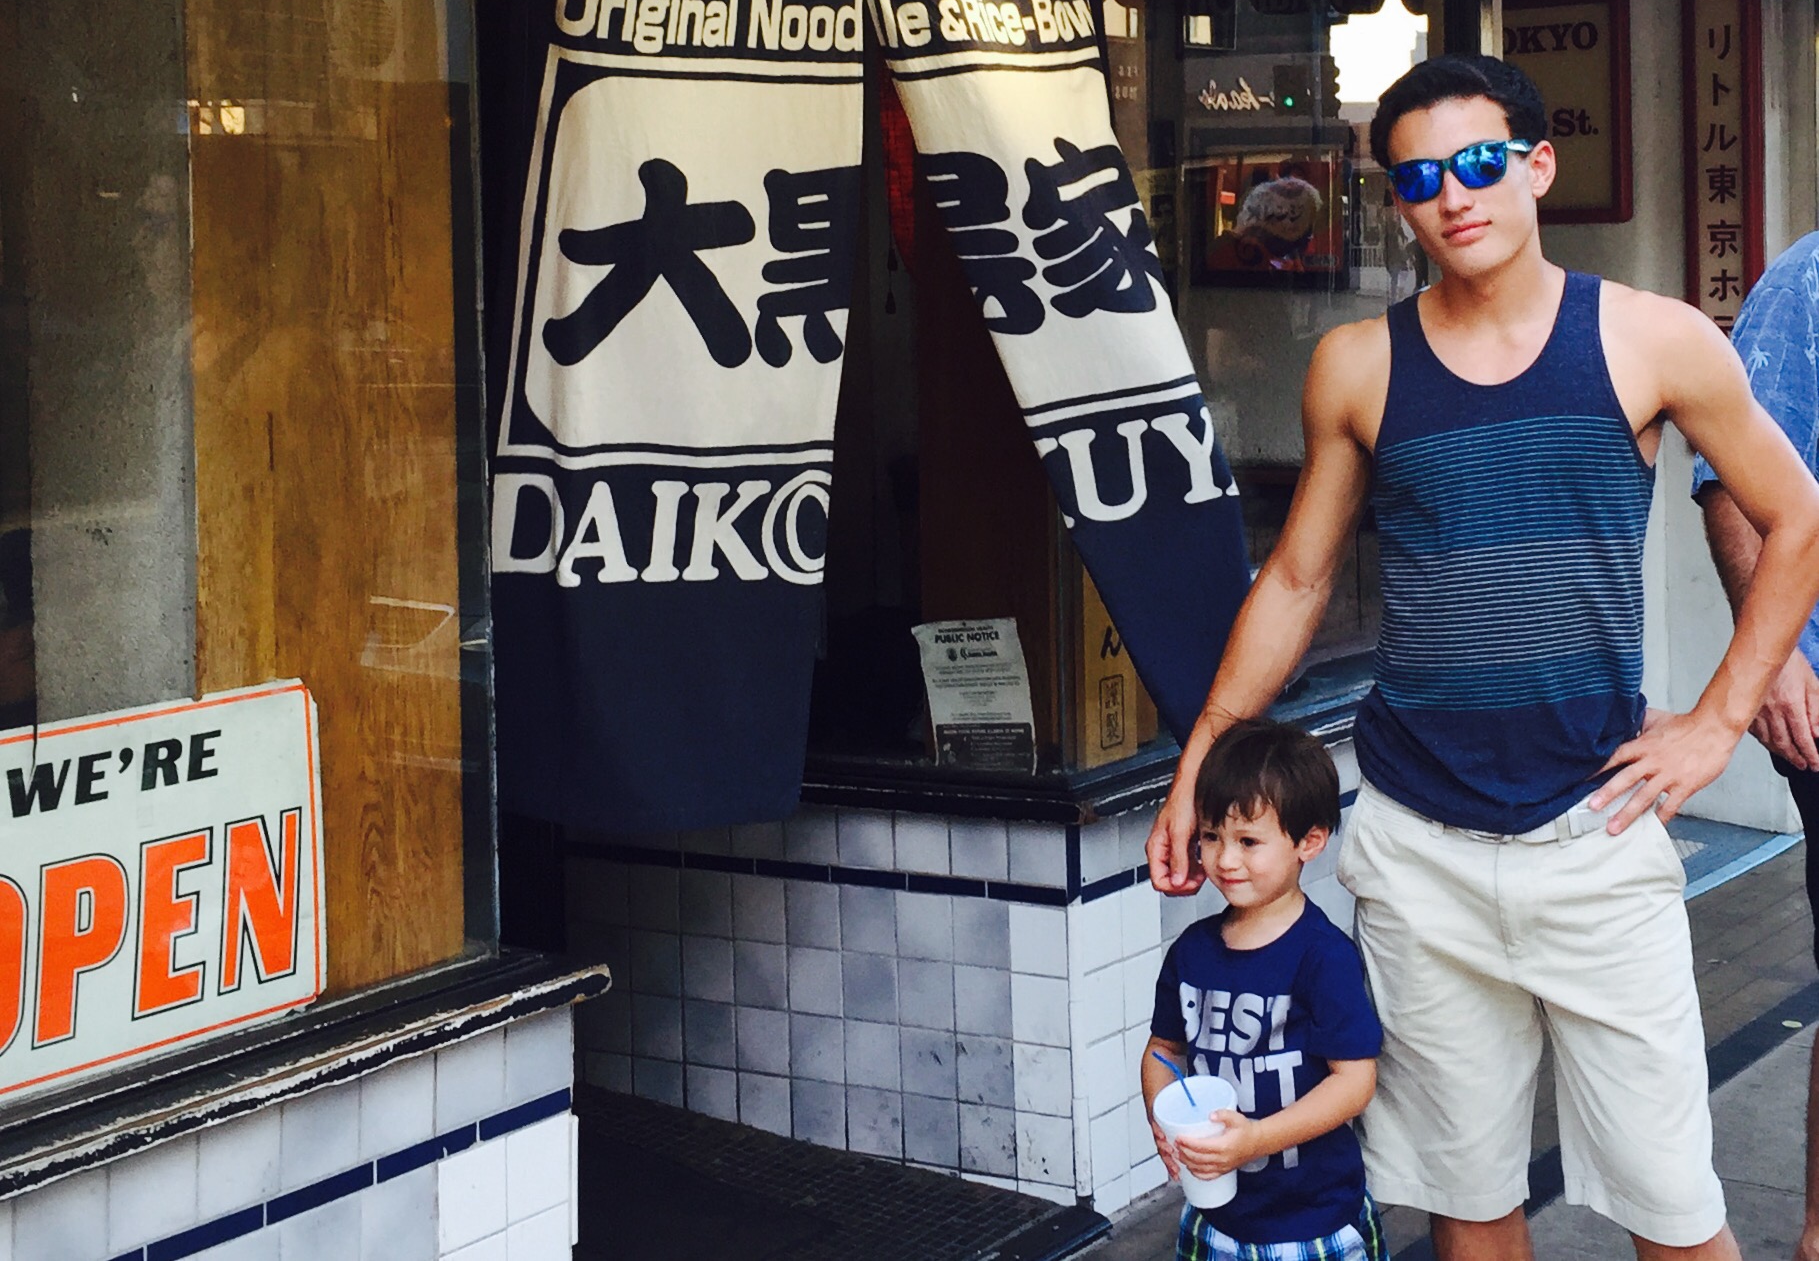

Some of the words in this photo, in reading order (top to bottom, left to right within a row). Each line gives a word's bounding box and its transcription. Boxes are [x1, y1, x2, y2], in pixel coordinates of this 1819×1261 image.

[1551, 107, 1600, 138] St.
[1033, 406, 1241, 529] UY
[934, 632, 965, 644] PUBLIC
[966, 630, 1001, 643] NOTICE
[6, 729, 222, 819] WE'RE
